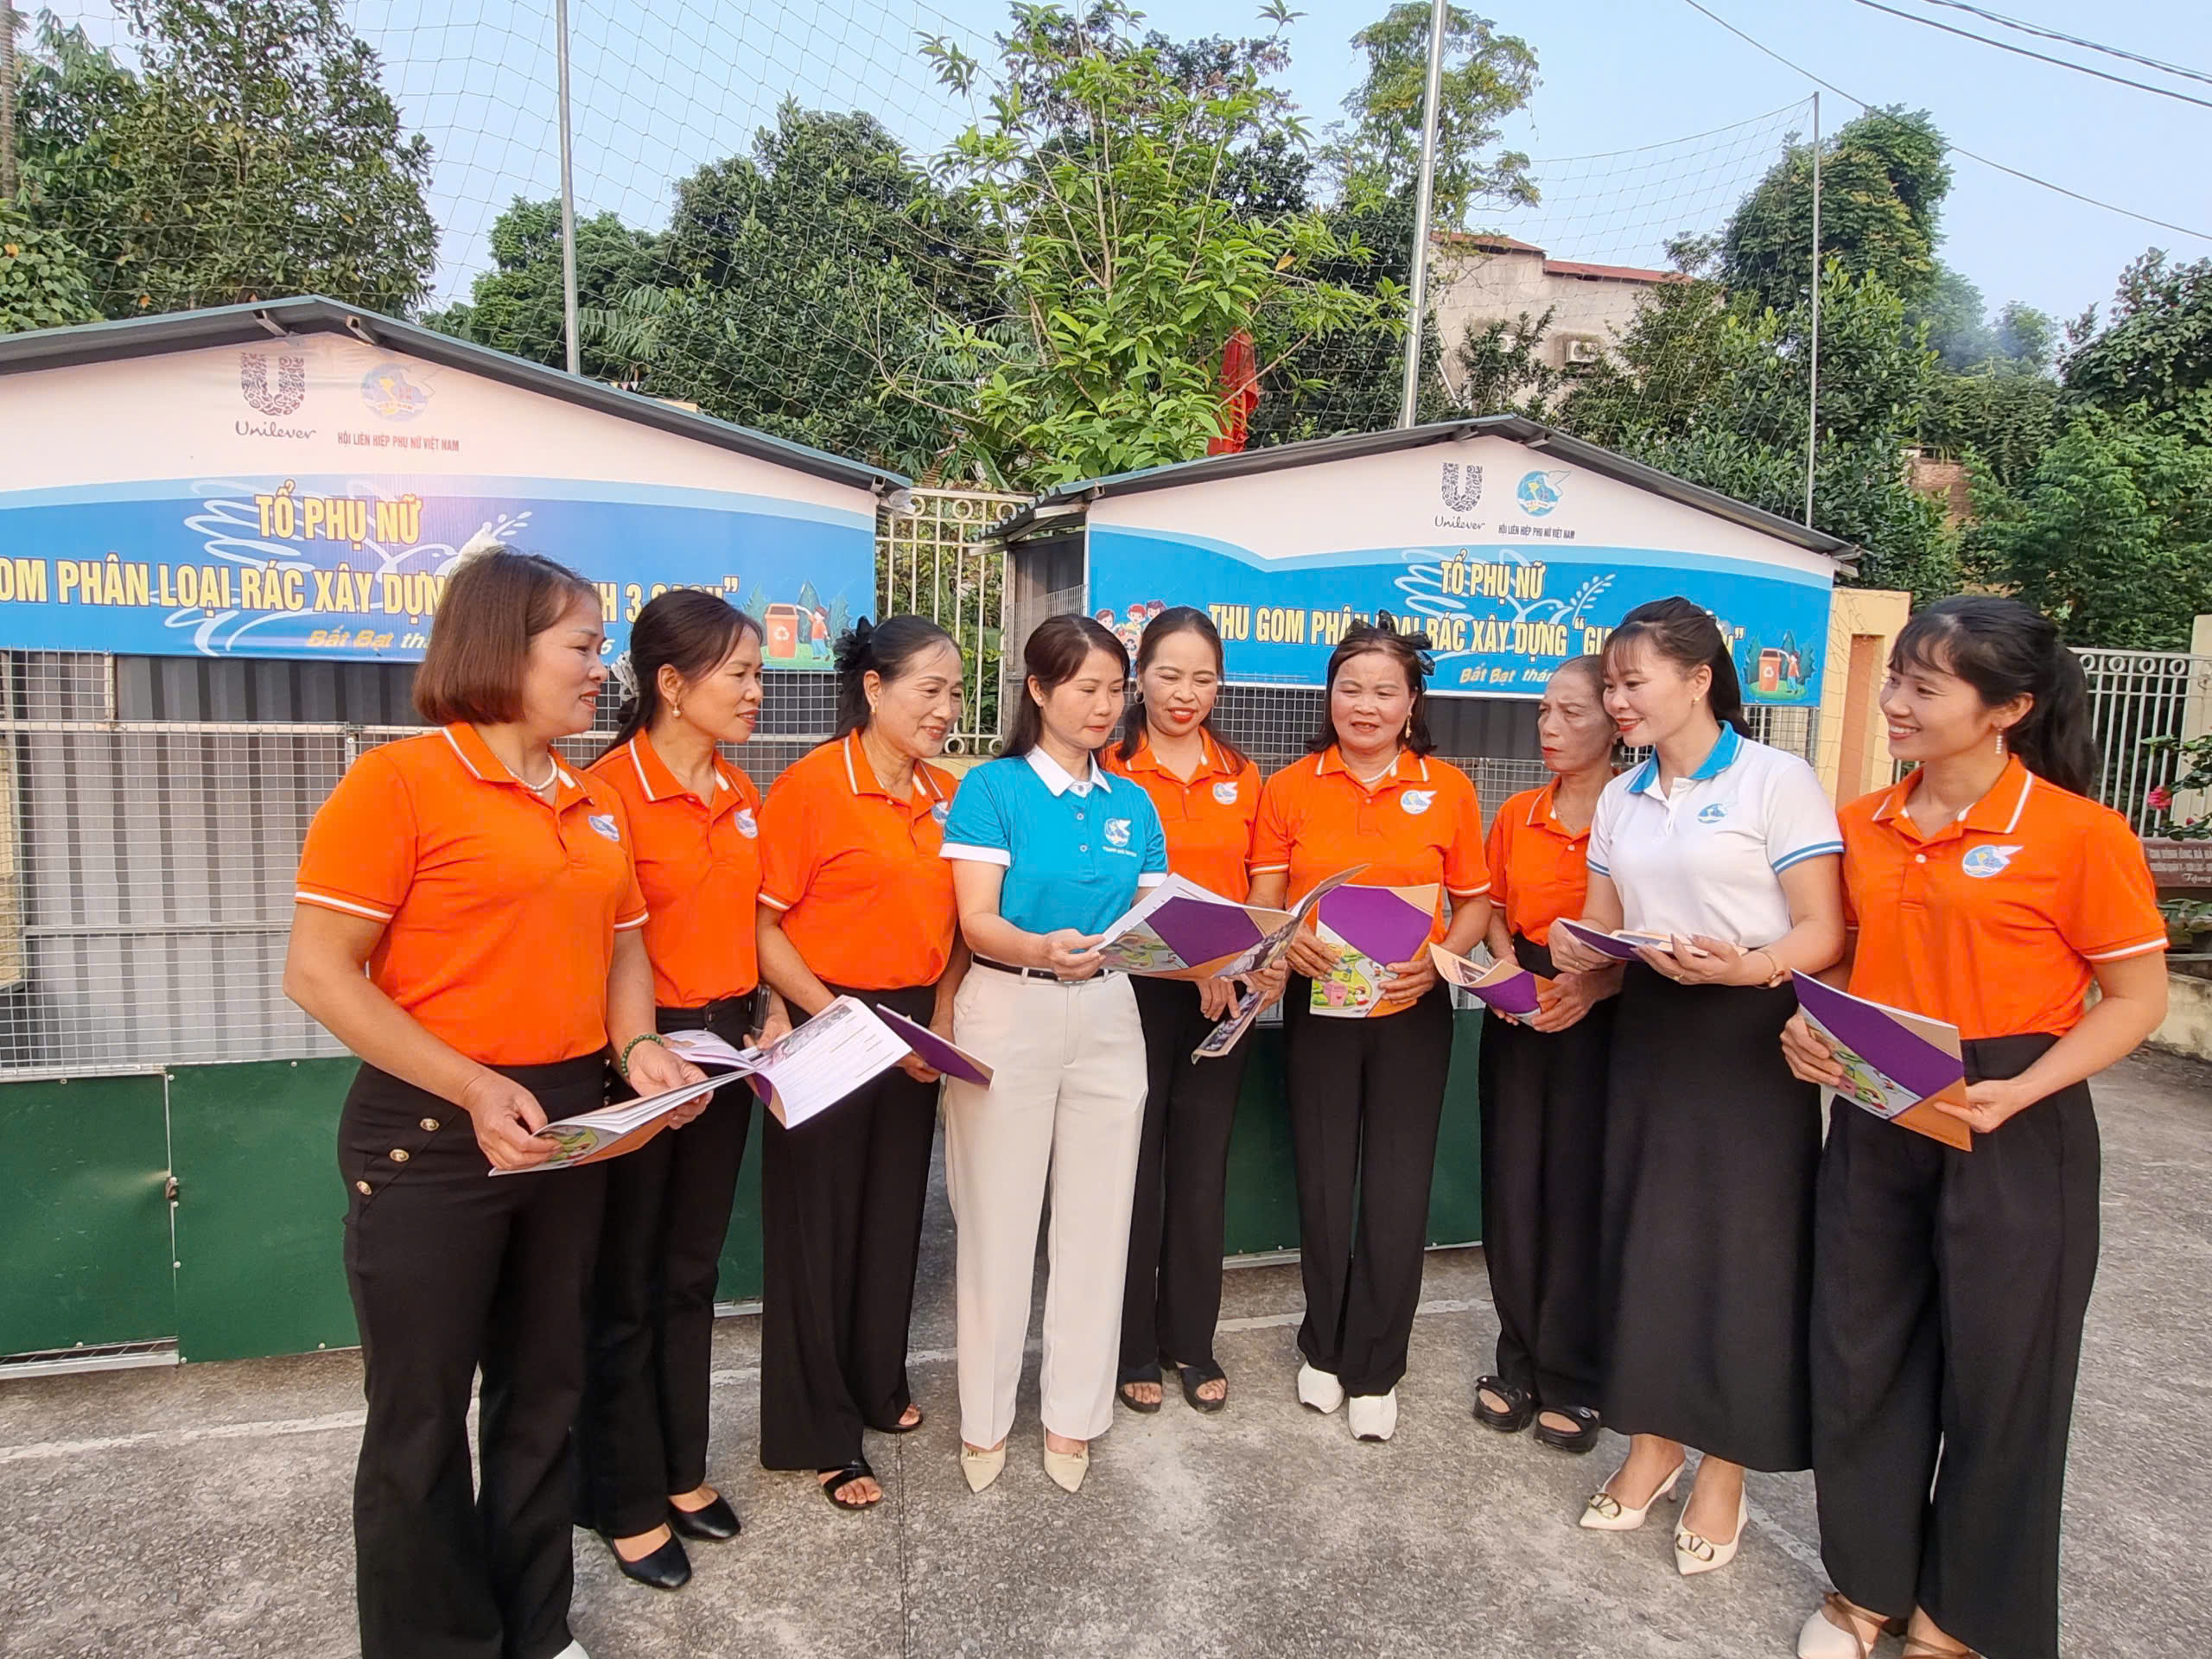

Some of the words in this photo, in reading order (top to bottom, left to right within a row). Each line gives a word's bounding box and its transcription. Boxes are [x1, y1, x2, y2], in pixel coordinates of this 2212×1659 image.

[235, 421, 316, 439] Unilever
[442, 439, 460, 451] NAM
[255, 479, 296, 539] TỔ
[303, 496, 367, 550] PHỤ
[375, 493, 423, 545] NỮ
[1434, 516, 1485, 530] Unilever
[0, 556, 48, 603] OM
[56, 551, 151, 607] PHÂN
[158, 563, 232, 619] LOẠI
[239, 558, 305, 613] RÁC
[311, 562, 375, 614] XÂY
[381, 569, 448, 625] DỰN
[1440, 547, 1468, 596] TỔ
[1470, 562, 1510, 606] PHỤ
[1515, 560, 1547, 601] NỮ
[307, 625, 351, 646] Bất
[353, 629, 394, 652] Bạt
[1208, 602, 1251, 642] THU
[1255, 605, 1306, 645] GOM
[1426, 610, 1466, 653] RÁC
[1470, 613, 1512, 654] XÂY
[1513, 620, 1569, 664] DỰNG
[1459, 661, 1487, 684] Bất
[1489, 665, 1516, 686] Bạt
